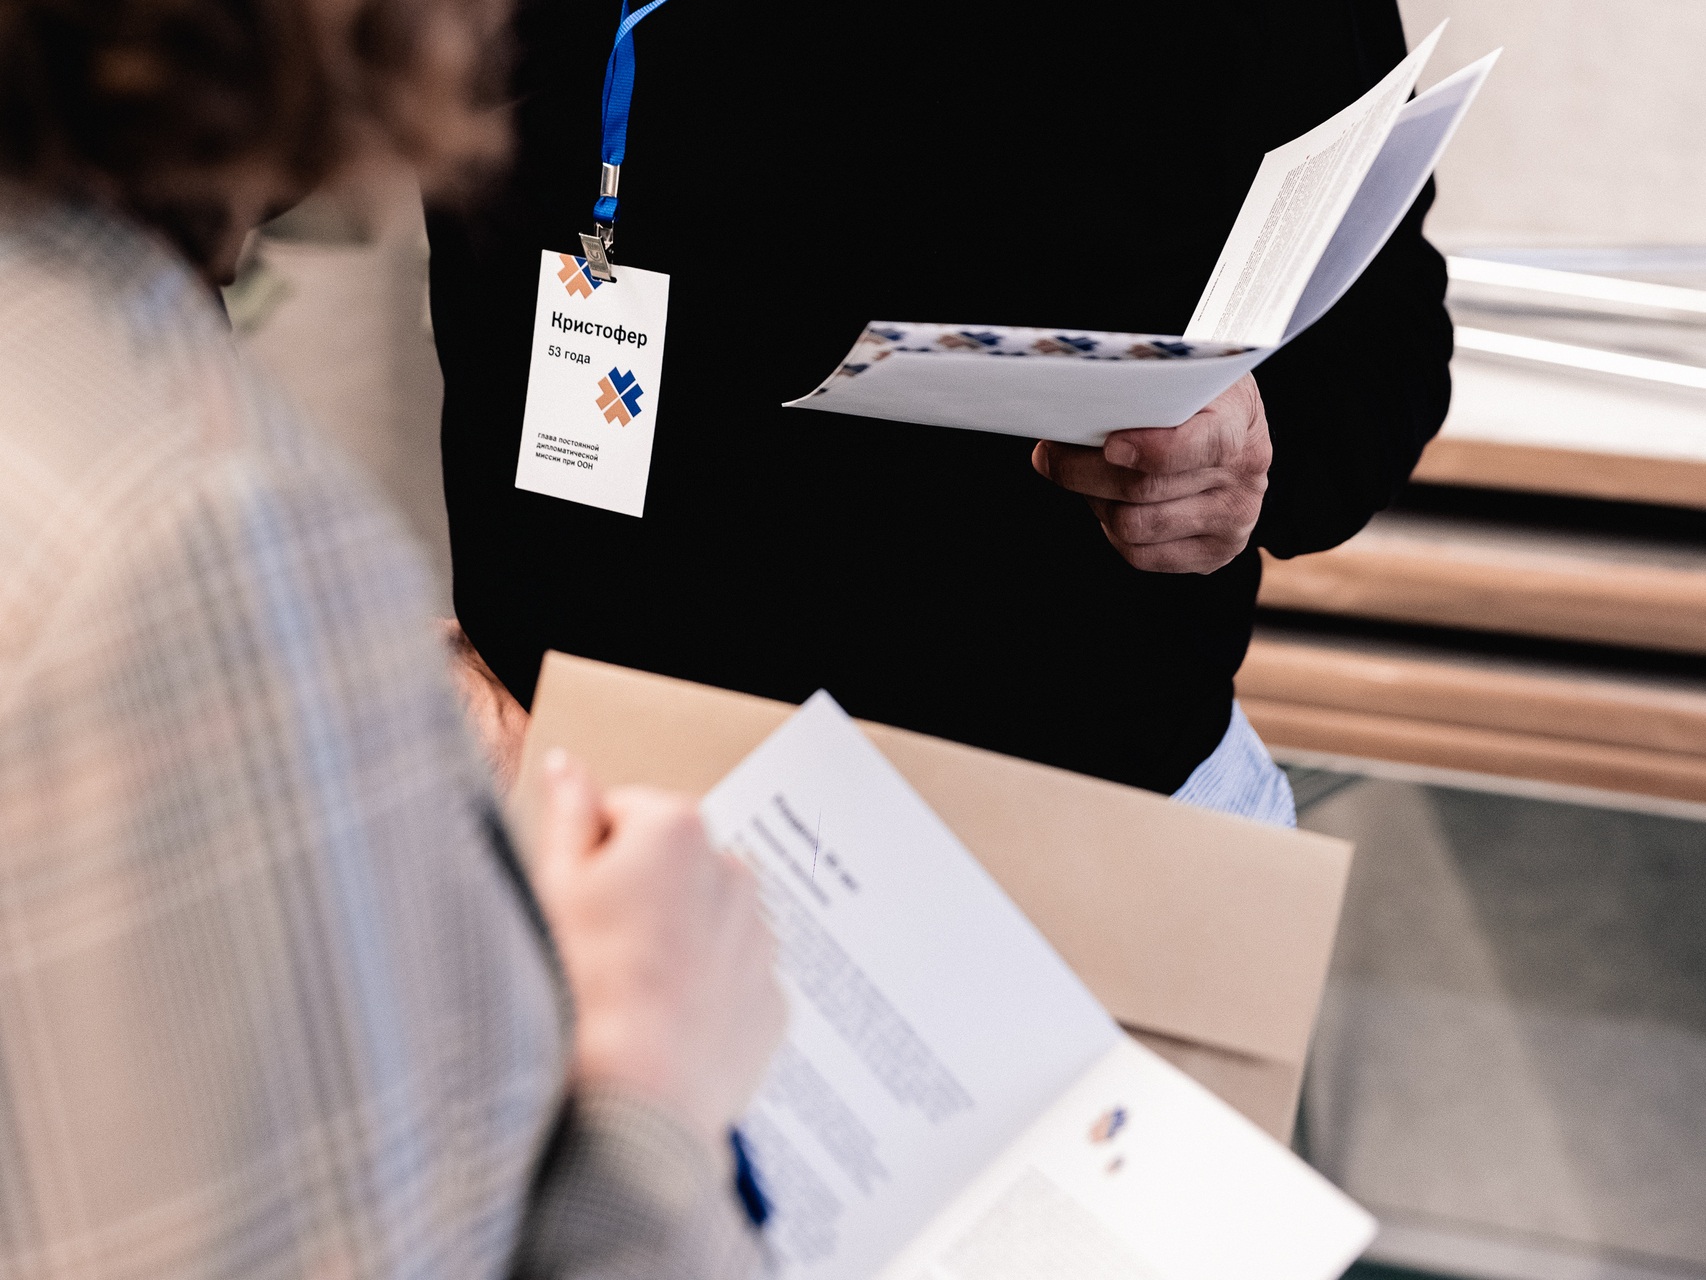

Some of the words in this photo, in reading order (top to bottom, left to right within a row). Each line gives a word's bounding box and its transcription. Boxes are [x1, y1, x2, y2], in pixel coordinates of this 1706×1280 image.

[551, 311, 648, 349] Кристофер
[548, 345, 562, 357] 53
[564, 350, 591, 365] года
[536, 442, 599, 461] дипломатической
[537, 432, 557, 442] глава
[558, 437, 600, 452] постоянной
[535, 451, 561, 463] миссии
[562, 458, 576, 466] при
[577, 460, 594, 470] ООН
